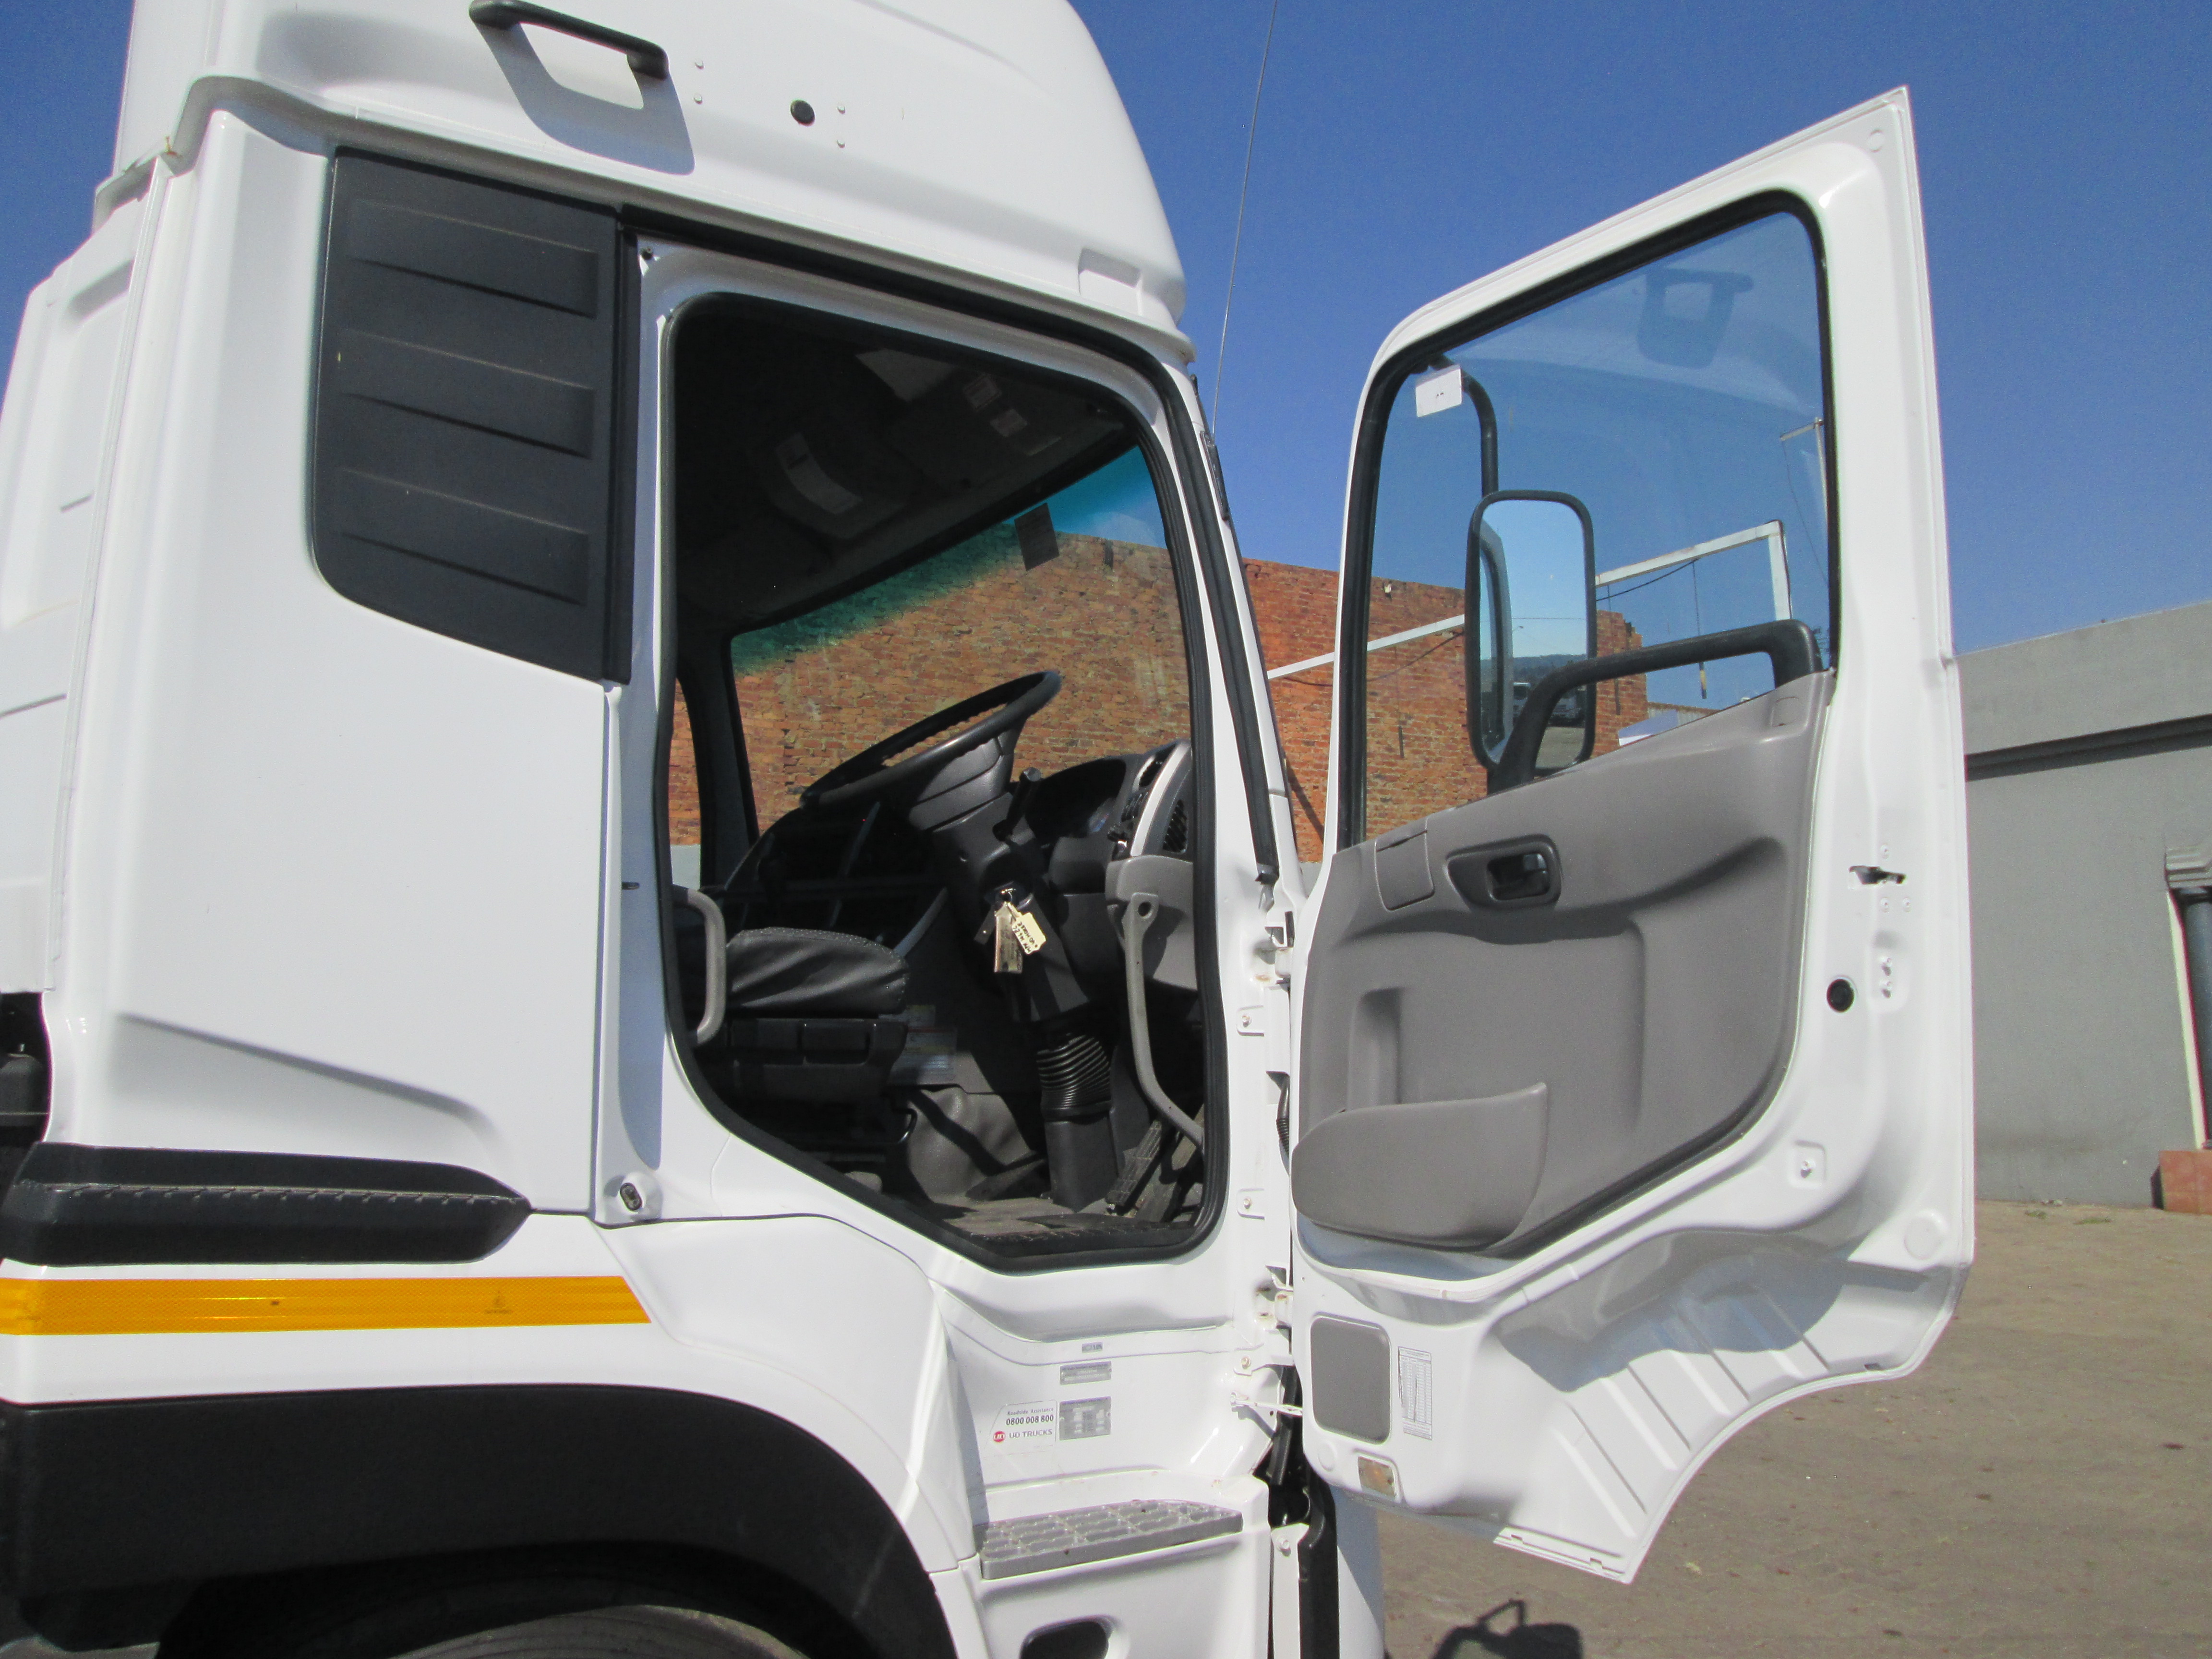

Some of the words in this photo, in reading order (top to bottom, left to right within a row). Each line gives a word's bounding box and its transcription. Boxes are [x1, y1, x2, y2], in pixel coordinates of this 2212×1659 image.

[1006, 1417, 1024, 1426] 0800
[1025, 1416, 1039, 1424] 008
[1041, 1414, 1054, 1423] 800
[1022, 1429, 1053, 1437] TRUCKS
